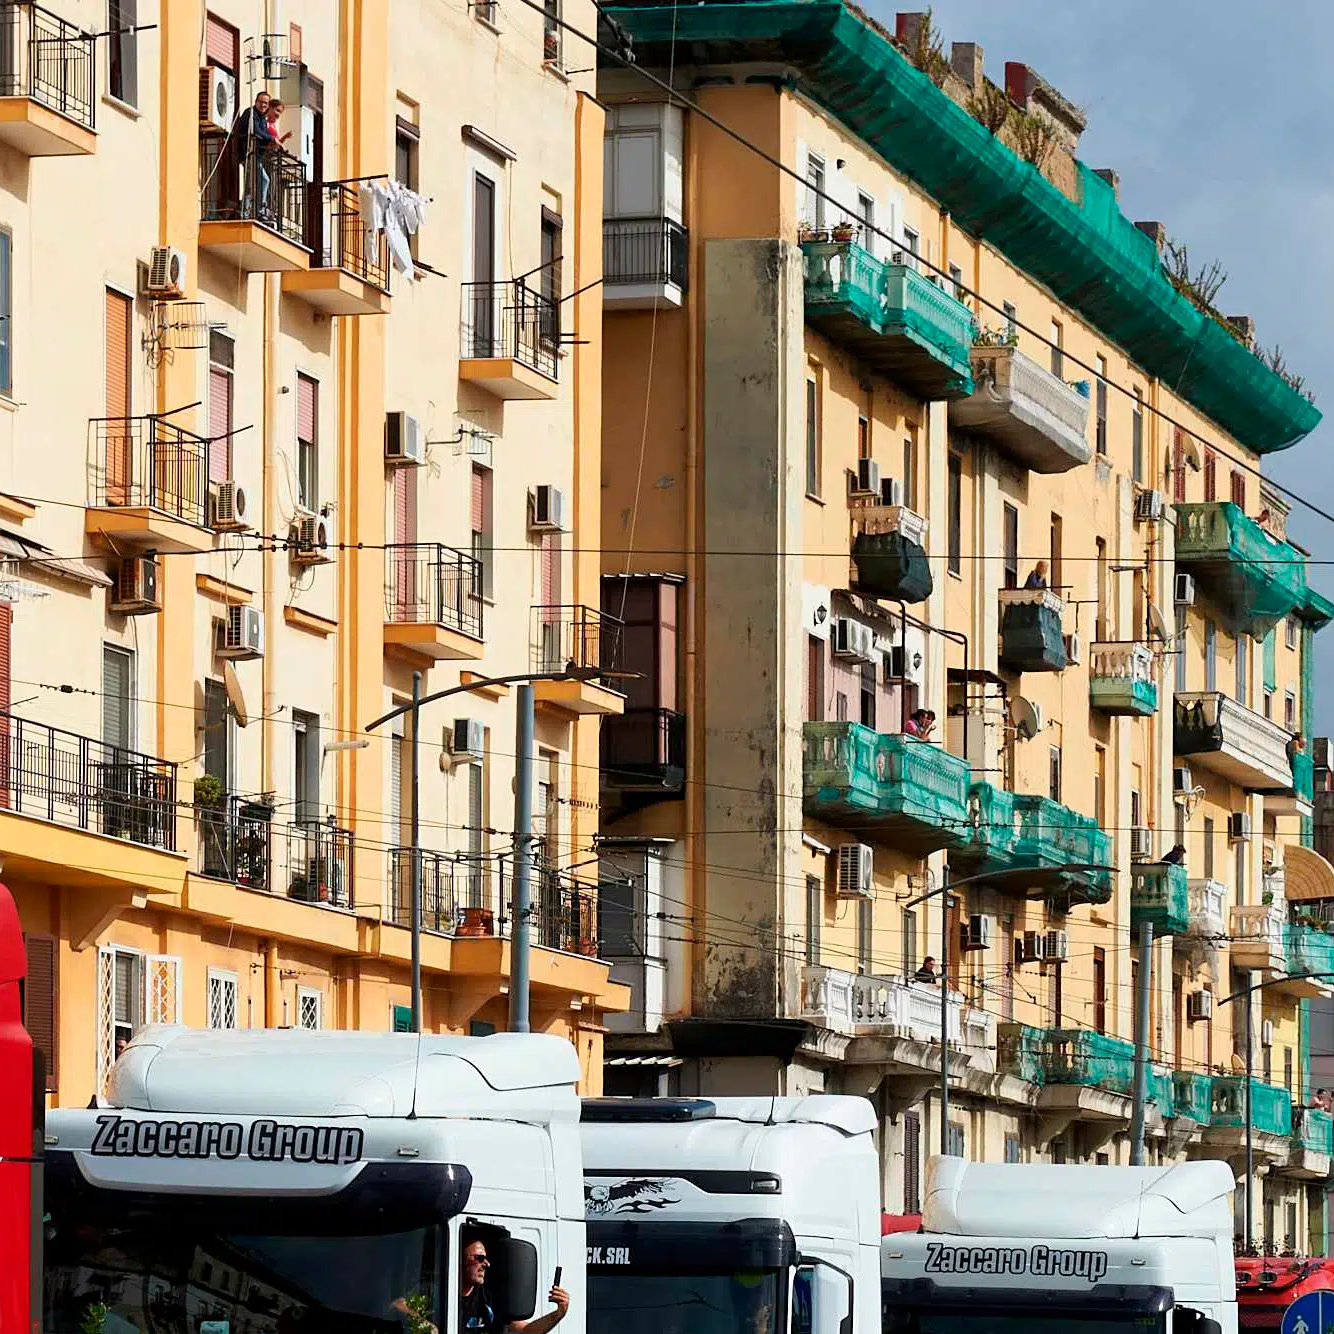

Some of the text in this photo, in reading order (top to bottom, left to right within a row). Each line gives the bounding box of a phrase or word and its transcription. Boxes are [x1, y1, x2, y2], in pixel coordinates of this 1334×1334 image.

[91, 1115, 364, 1166] Zaccaro Group
[925, 1242, 1108, 1282] Zaccaro Group
